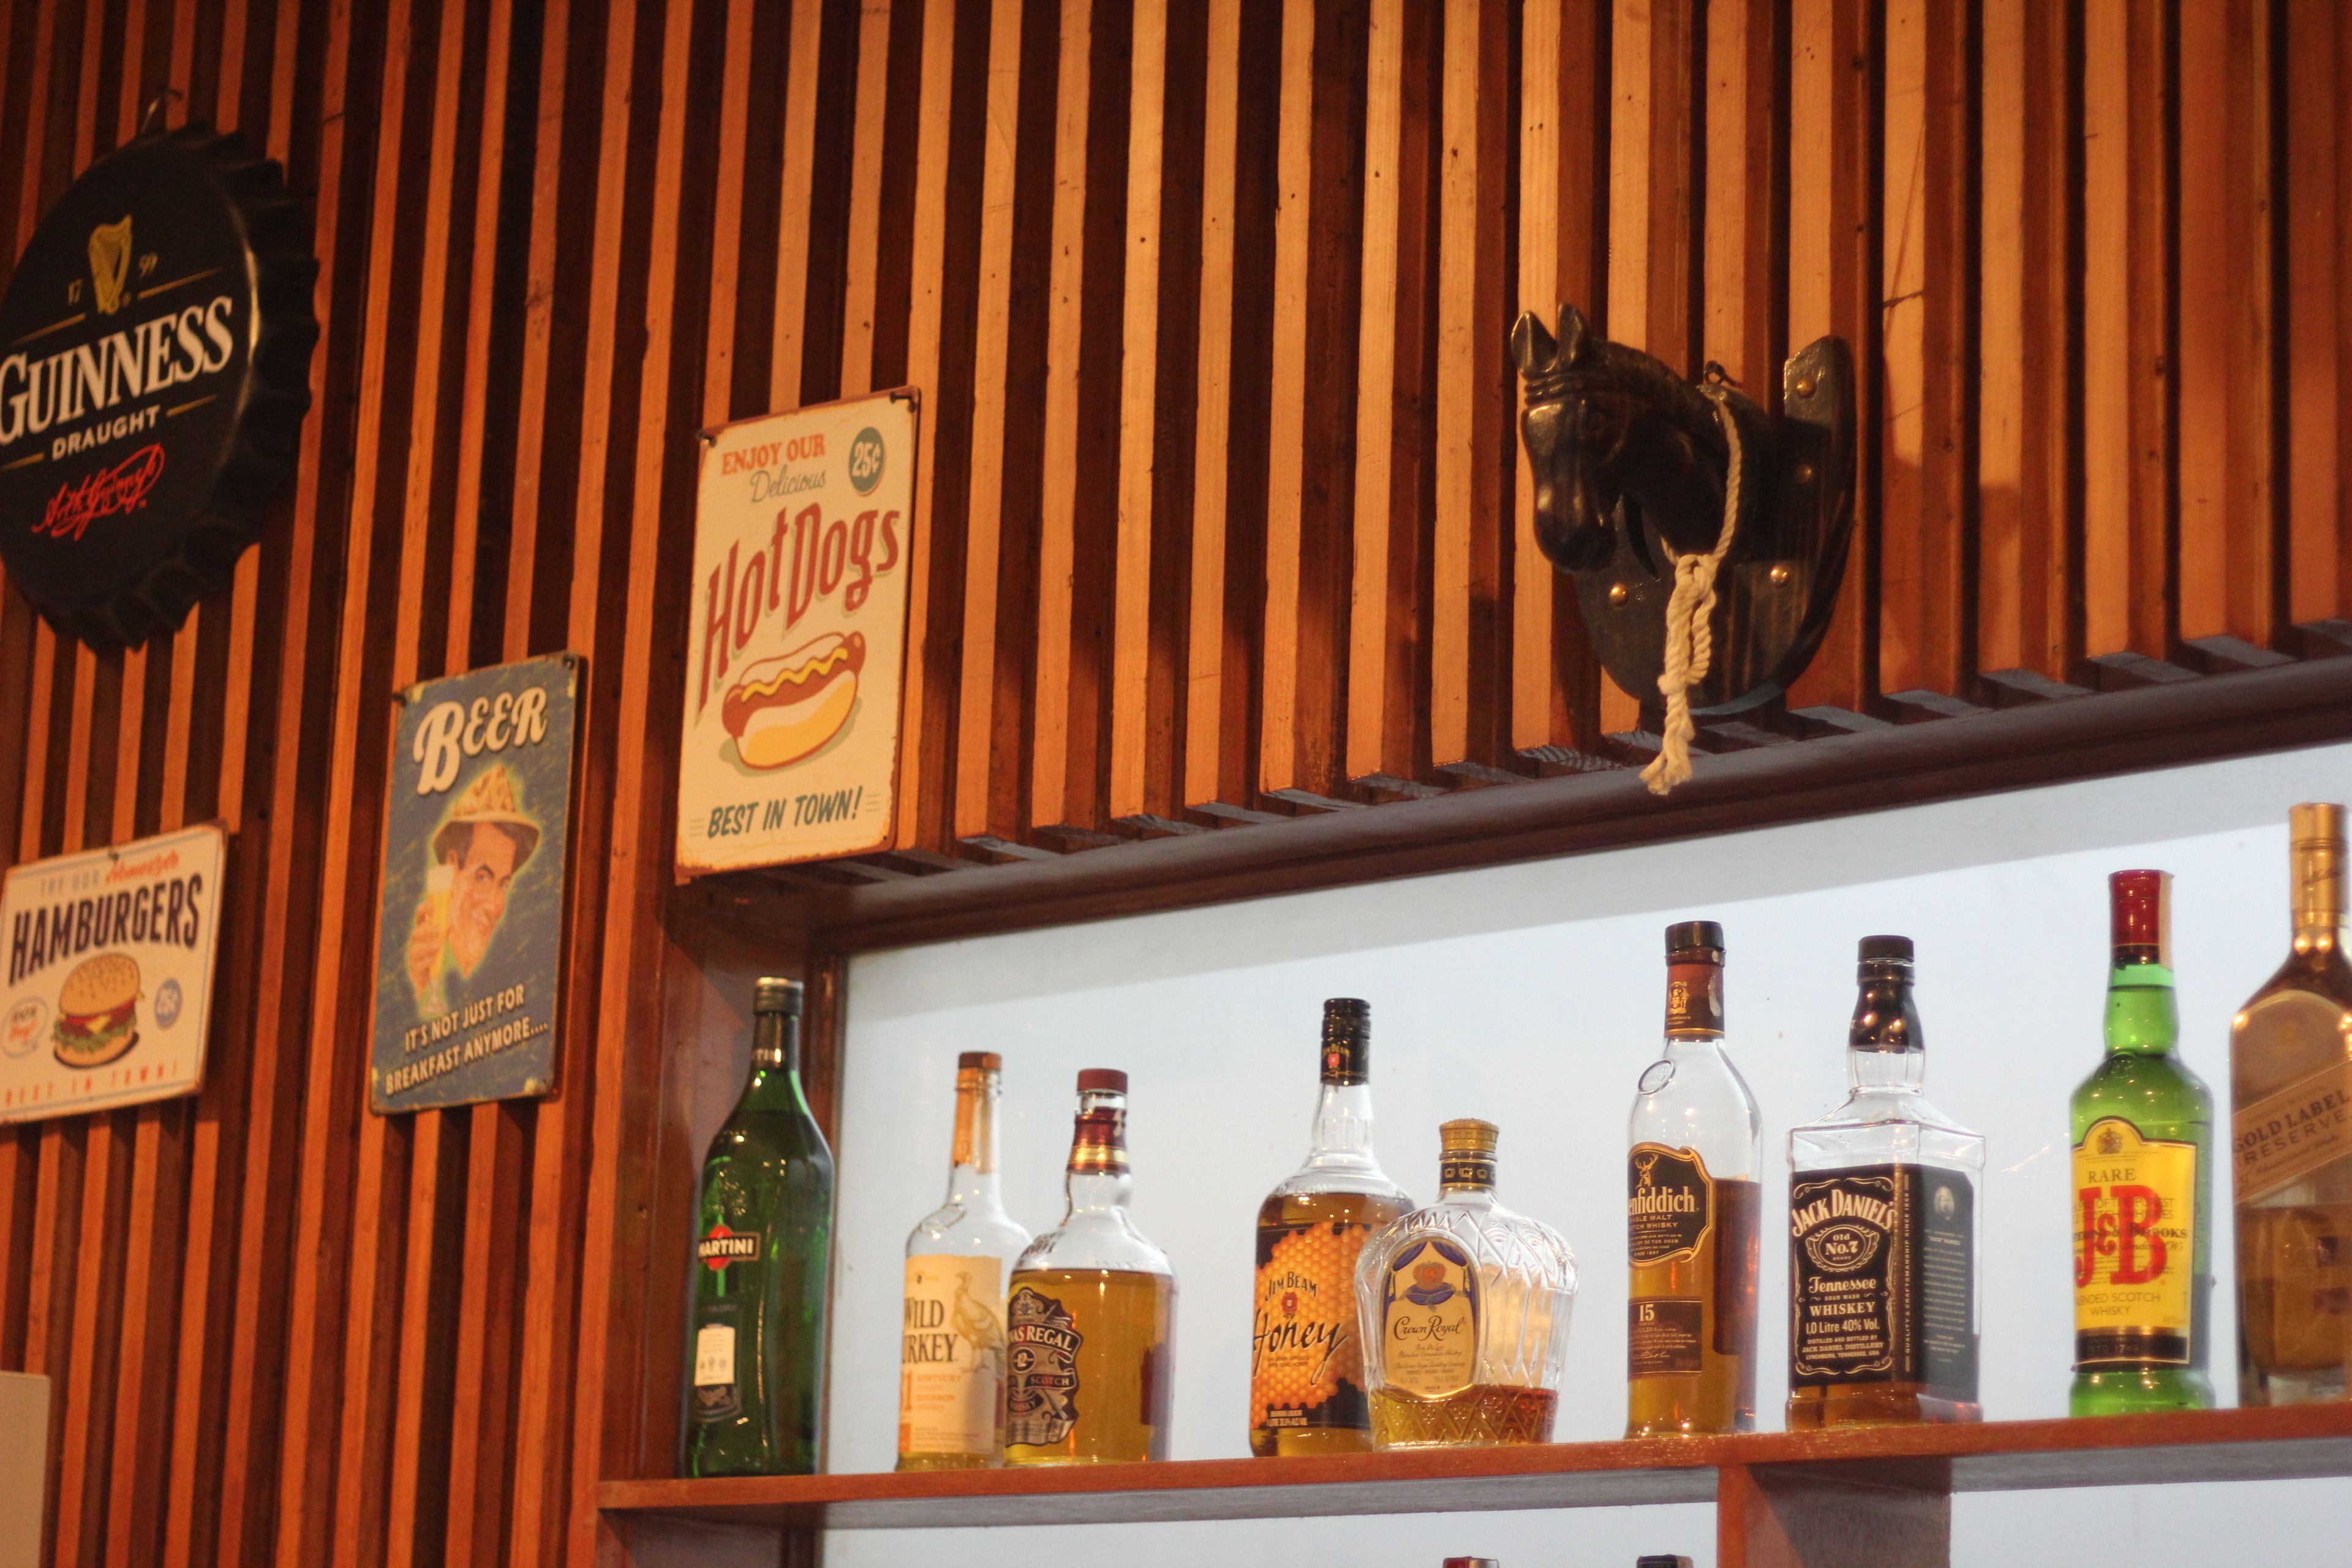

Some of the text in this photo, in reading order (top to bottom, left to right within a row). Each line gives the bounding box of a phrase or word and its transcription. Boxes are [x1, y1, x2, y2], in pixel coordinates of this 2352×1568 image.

[0, 296, 233, 445] GUINNESS
[52, 405, 160, 461] DRAUGHT
[722, 434, 826, 475] ENJOY OUR
[750, 464, 827, 503] Delicious
[413, 686, 548, 796] BEER
[707, 785, 863, 839] BEST IN TOWN!
[9, 873, 203, 987] HAMBURGERS
[404, 984, 525, 1053] IT'S NOT JUST FOR
[385, 1045, 461, 1096] BREAKFAST
[2234, 1089, 2351, 1153] GOLD LABEL
[2244, 1109, 2347, 1166] RESERVE
[2088, 1167, 2136, 1183] RARE
[1629, 1186, 1696, 1216] enfiddich
[1792, 1189, 1898, 1237] JACK DANIEL'S
[1833, 1233, 1851, 1242] Old
[1265, 1271, 1317, 1302] JIM BEAM
[1808, 1276, 1877, 1294] Tennessee
[2076, 1292, 2161, 1305] ENDED SCOTCH
[1639, 1303, 1655, 1322] 15
[1809, 1302, 1876, 1317] WHISKEY
[1819, 1321, 1840, 1334] Litre
[1842, 1319, 1863, 1332] 40%
[1864, 1317, 1880, 1331] Vol.
[2090, 1305, 2132, 1316] WHISKY
[1027, 1325, 1072, 1351] REGAL
[1394, 1315, 1464, 1341] Crown Royal
[902, 1333, 959, 1365] RKEY
[1253, 1308, 1349, 1385] Honey
[1031, 1376, 1070, 1386] SCOTCH
